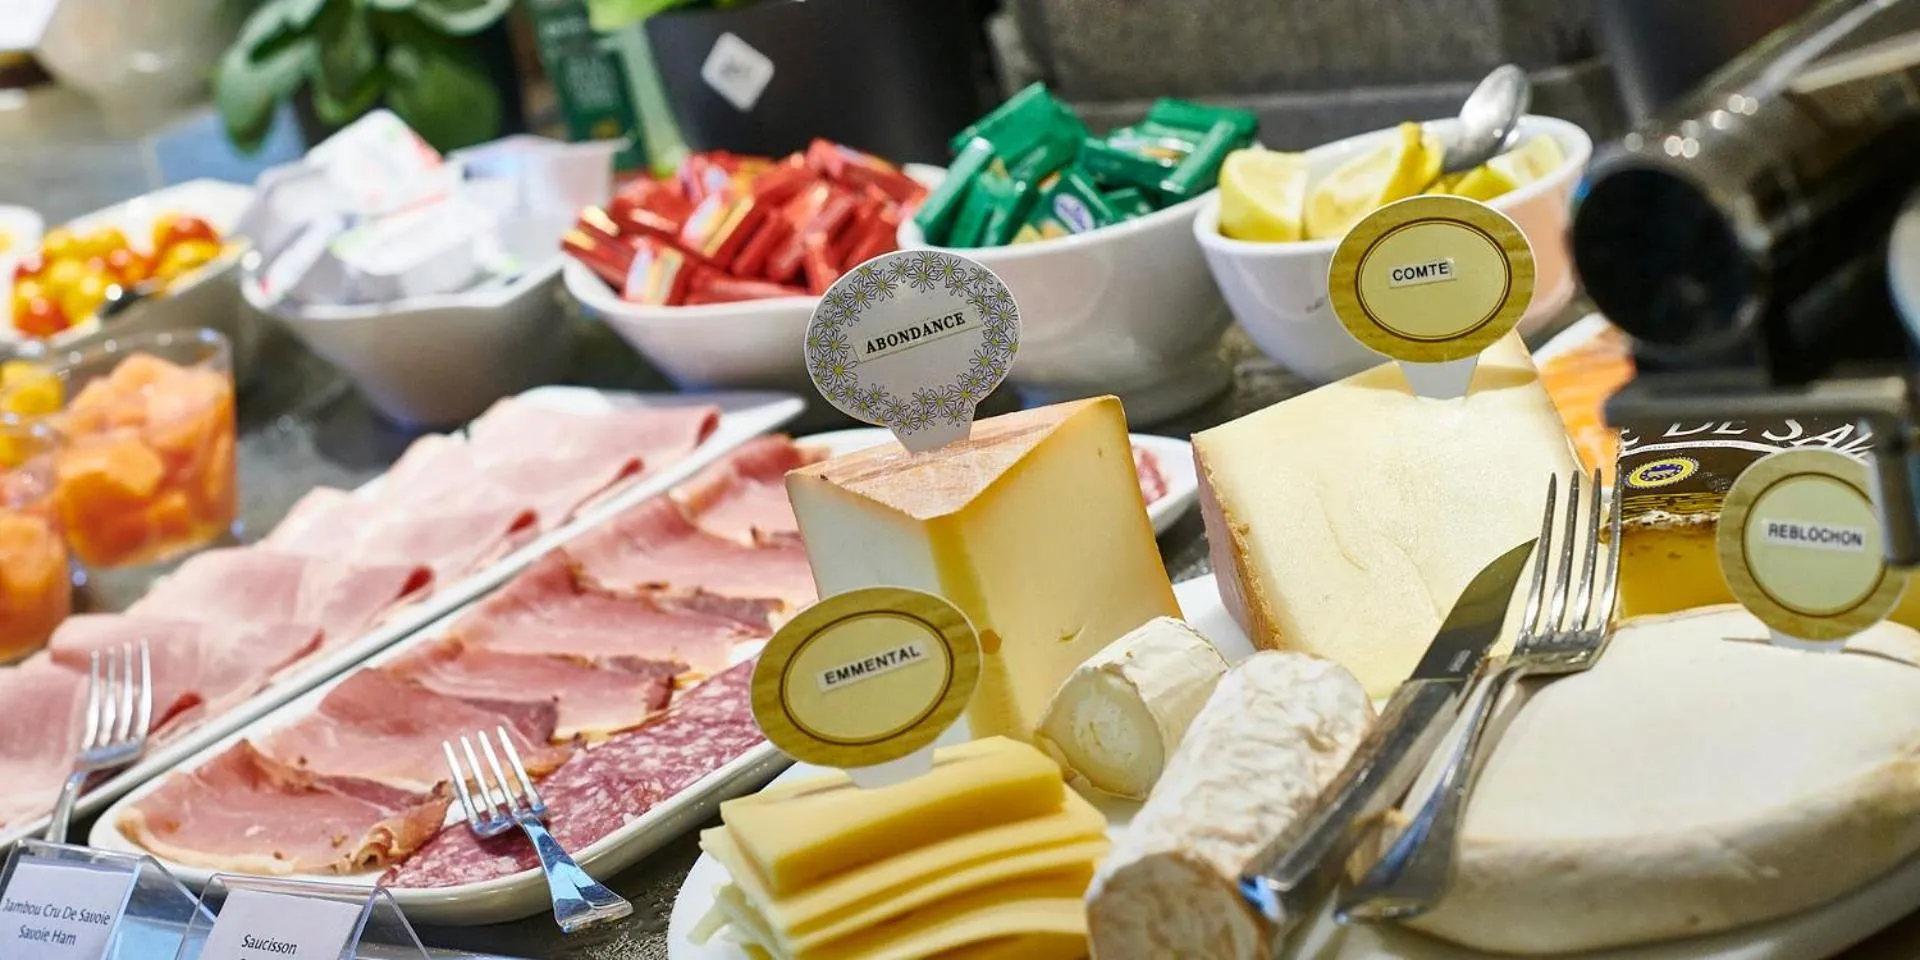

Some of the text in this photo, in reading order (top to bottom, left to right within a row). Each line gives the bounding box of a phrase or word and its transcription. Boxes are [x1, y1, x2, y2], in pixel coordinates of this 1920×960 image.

[1392, 261, 1449, 282] COMTE
[866, 312, 966, 354] ABONDANCE
[1767, 522, 1863, 546] REBLOCHON
[823, 645, 920, 685] EMMENTAL
[42, 903, 61, 918] Cru
[62, 905, 78, 921] De
[77, 907, 111, 926] Savoie
[18, 923, 77, 946] Savoie Ham
[241, 933, 298, 955] Saucisson
